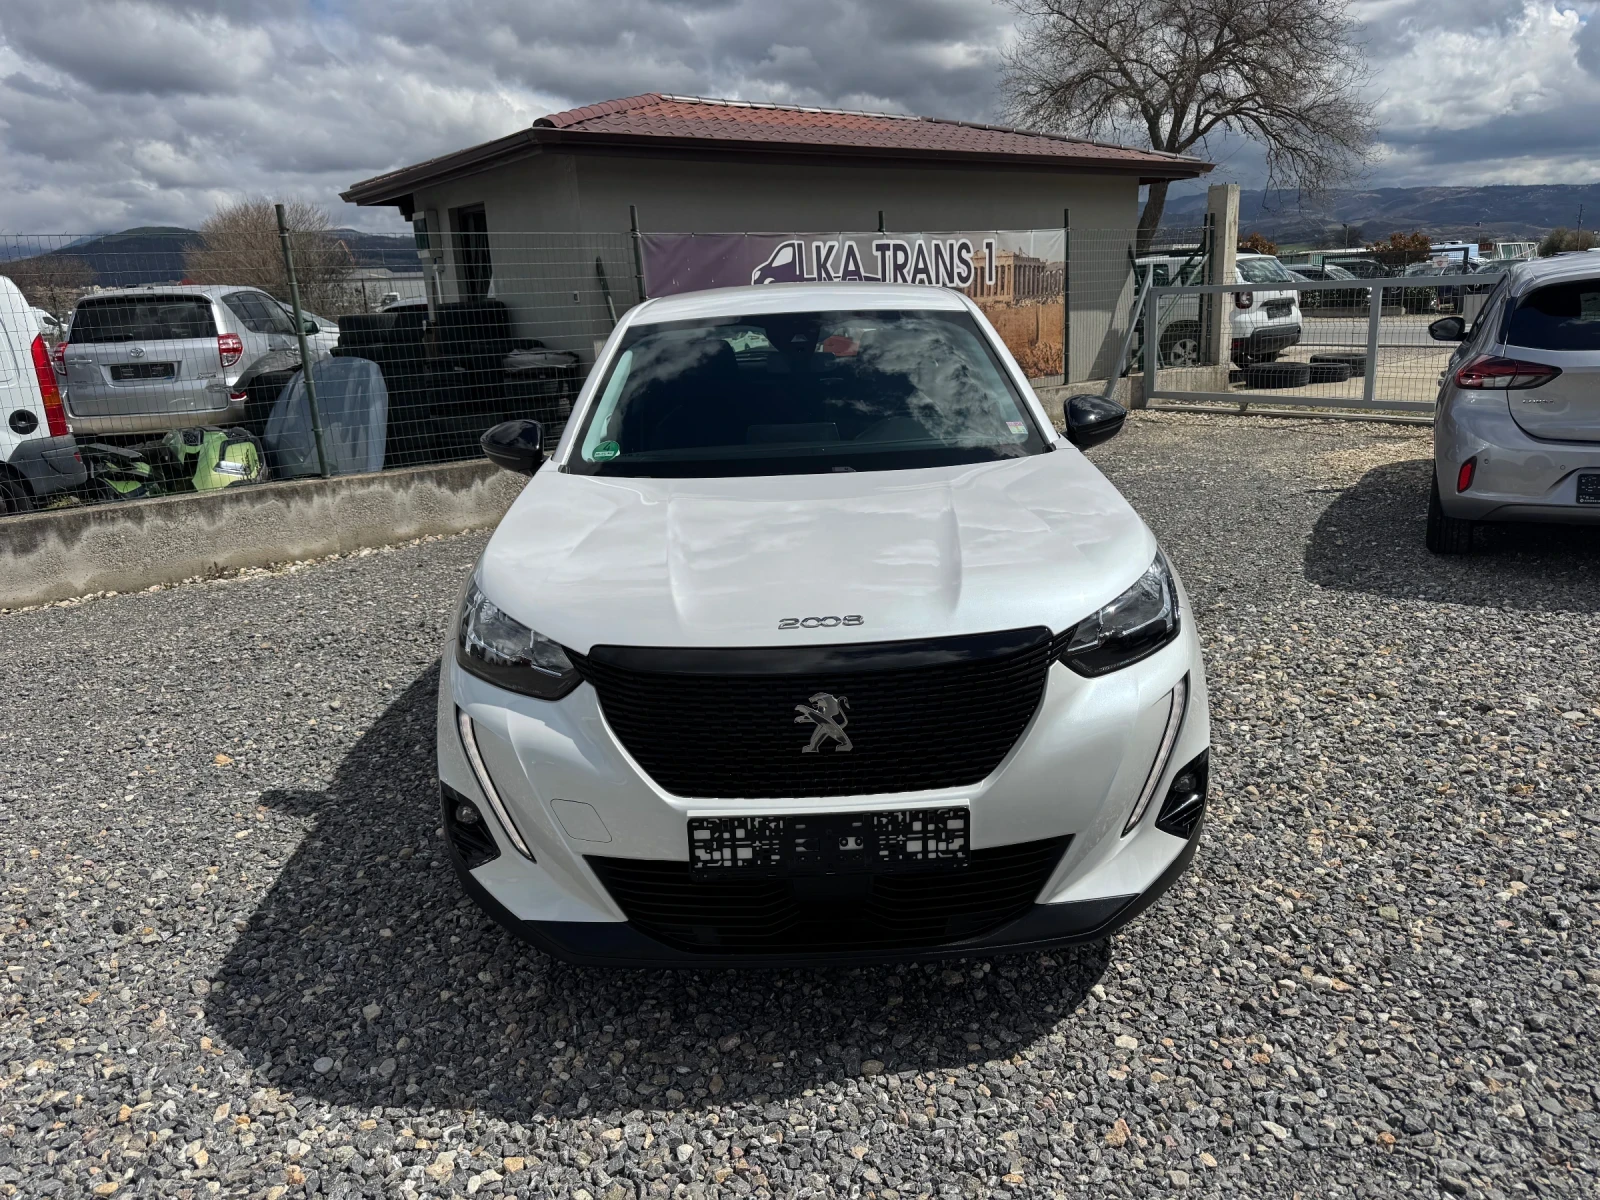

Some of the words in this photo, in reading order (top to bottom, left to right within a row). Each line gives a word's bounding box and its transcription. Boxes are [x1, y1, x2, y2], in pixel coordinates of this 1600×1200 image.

[874, 241, 974, 285] TRANS
[984, 240, 996, 284] 1
[603, 441, 611, 451] 4
[778, 615, 864, 630] 2008
